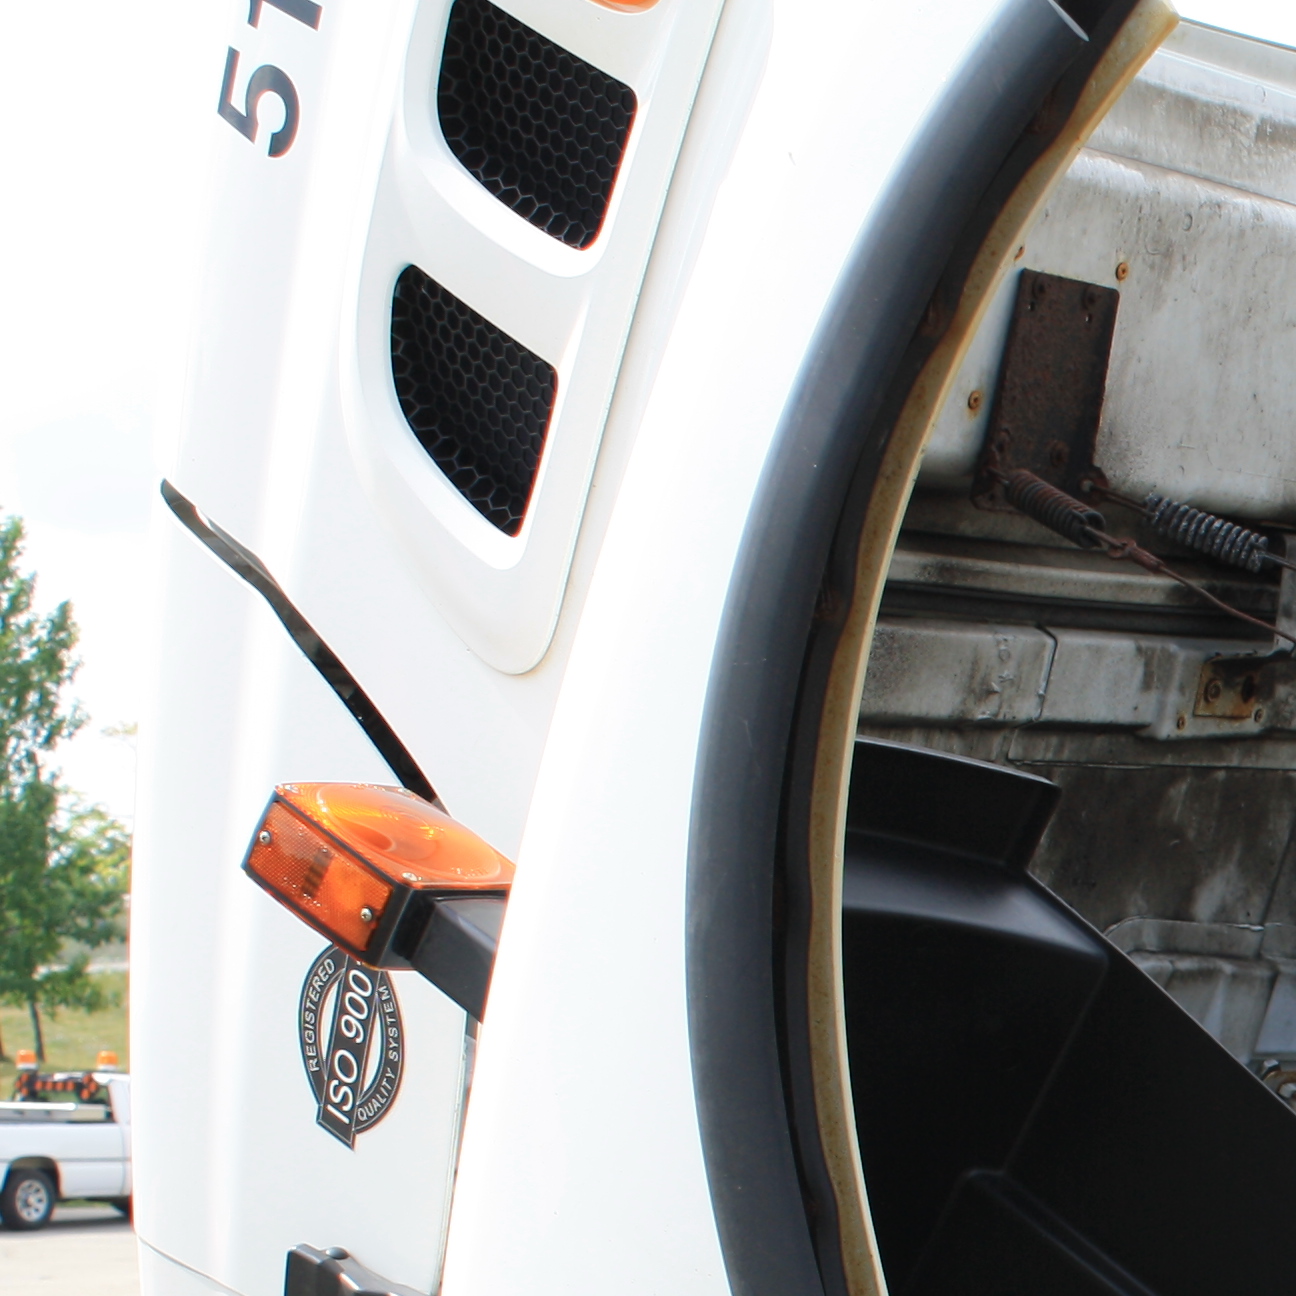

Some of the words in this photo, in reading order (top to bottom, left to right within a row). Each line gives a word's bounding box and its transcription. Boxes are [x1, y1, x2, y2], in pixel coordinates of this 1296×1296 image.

[303, 958, 336, 1072] REGISTERED
[341, 960, 373, 1044] 900
[327, 1048, 360, 1124] ISO
[357, 1067, 396, 1122] QUALITY
[377, 985, 400, 1062] SYSTEM
